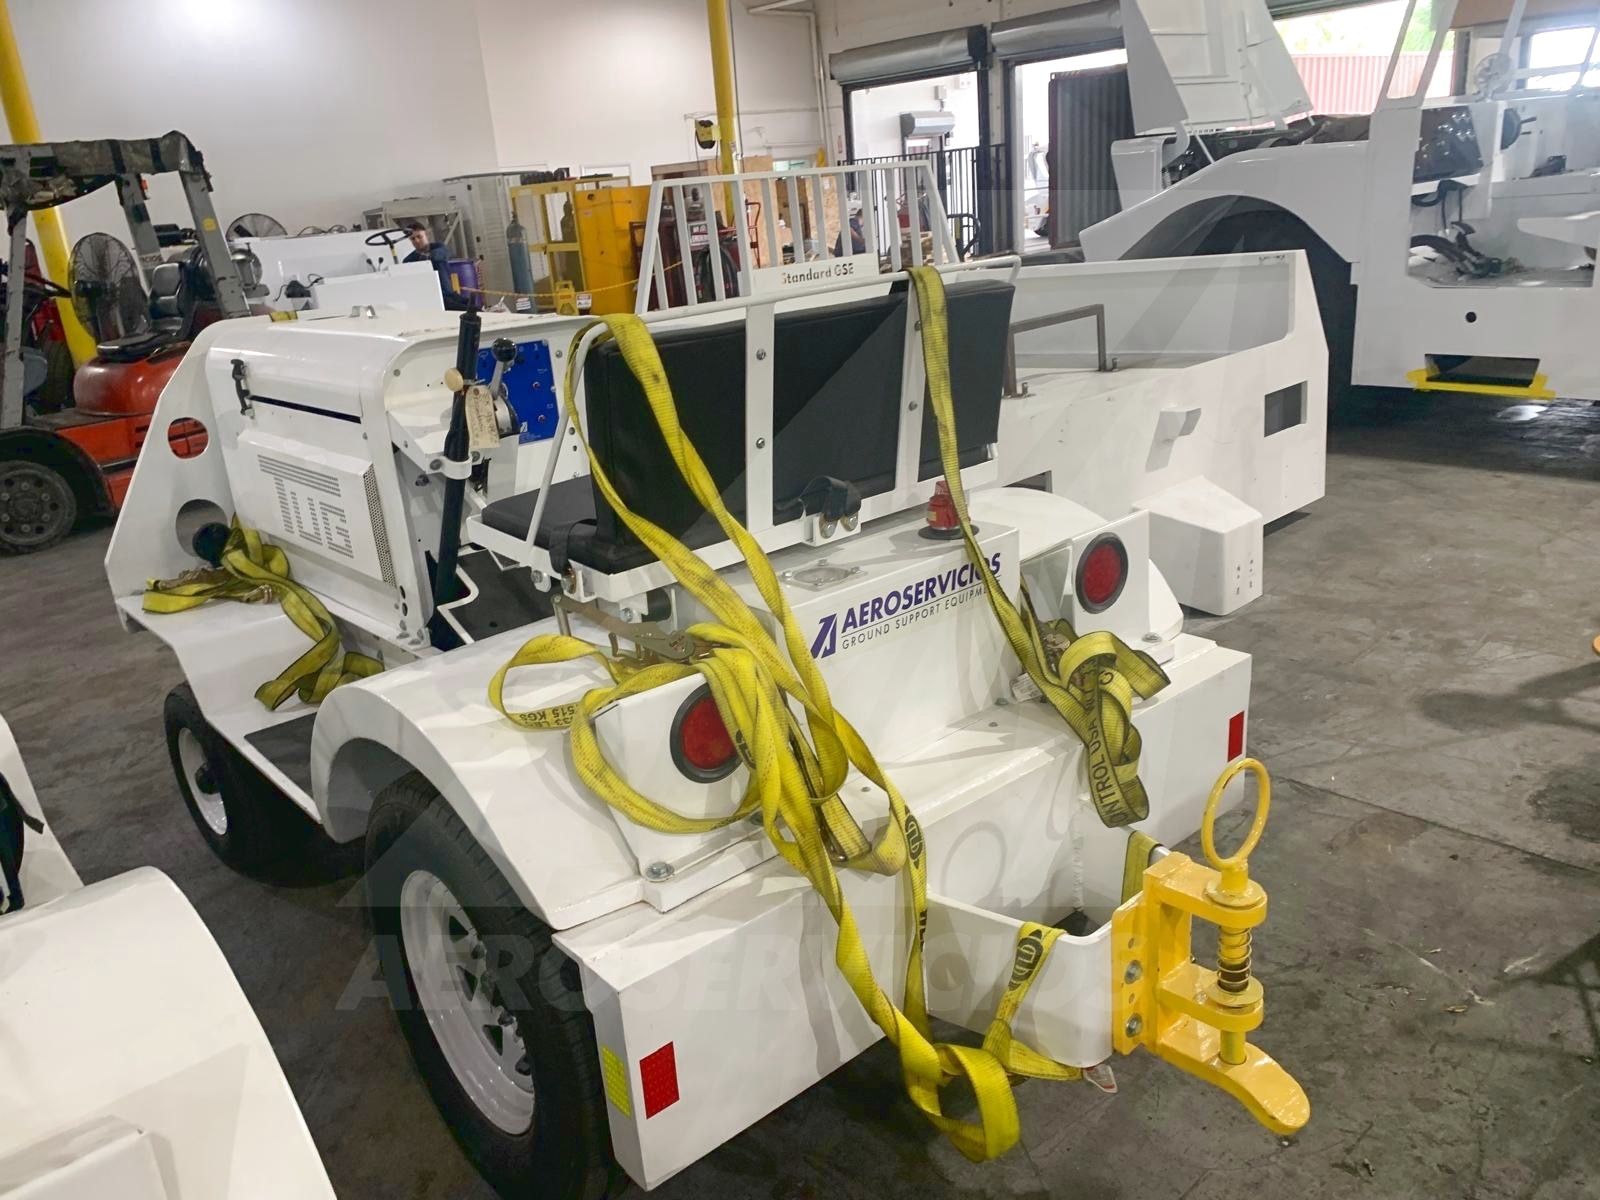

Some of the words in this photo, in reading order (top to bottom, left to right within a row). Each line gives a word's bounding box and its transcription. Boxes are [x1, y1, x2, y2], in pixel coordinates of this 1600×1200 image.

[781, 266, 831, 284] Standard
[834, 263, 854, 277] GSE
[256, 454, 354, 560] TUG
[841, 552, 1001, 634] AEROSERVICIOS
[842, 622, 890, 650] GROUND
[895, 603, 941, 629] SUPPORT
[945, 582, 989, 610] EQUIPM
[1092, 753, 1129, 823] ONTROL
